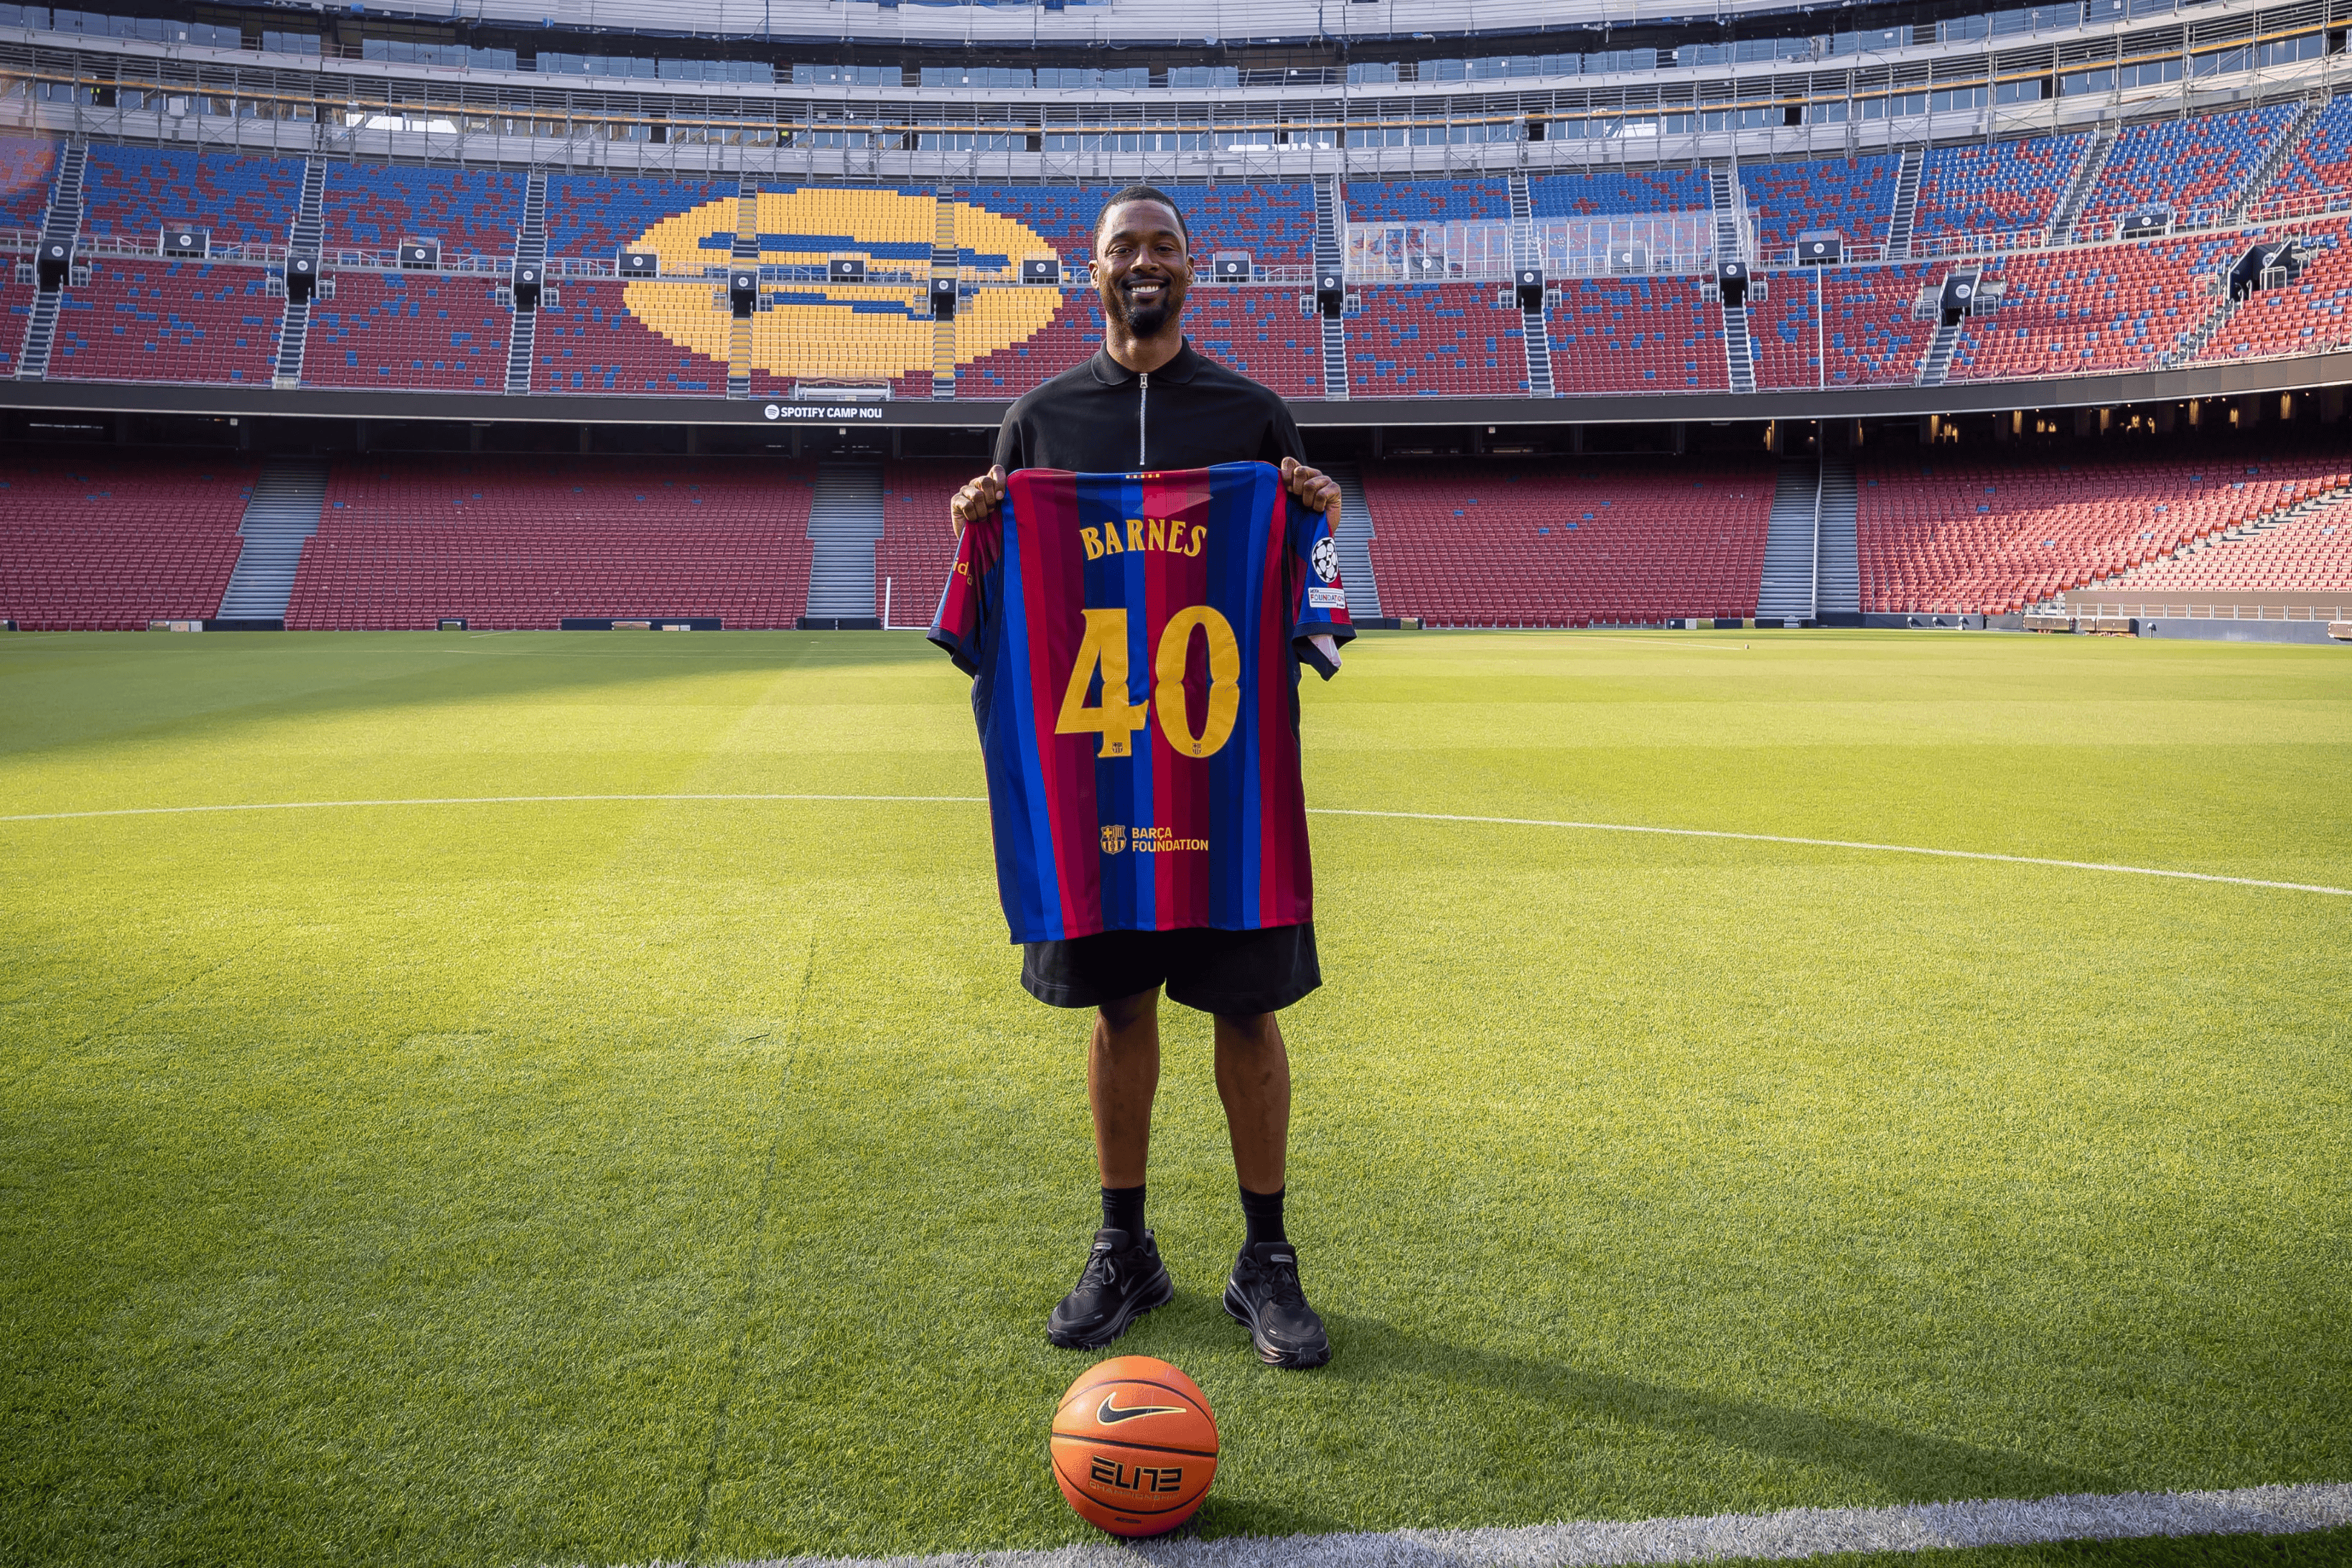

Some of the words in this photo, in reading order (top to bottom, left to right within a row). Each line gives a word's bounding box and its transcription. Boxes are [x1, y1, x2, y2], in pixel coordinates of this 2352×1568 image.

[780, 407, 825, 418] SPOTIFY
[827, 407, 857, 418] CAMP
[859, 408, 882, 418] NOU
[1079, 518, 1207, 560] BARNES
[1326, 551, 1332, 569] 5
[1055, 605, 1240, 758] 40
[1131, 827, 1172, 841] BARÇA
[1132, 839, 1208, 852] FOUNDATION
[1090, 1455, 1183, 1493] ELITE
